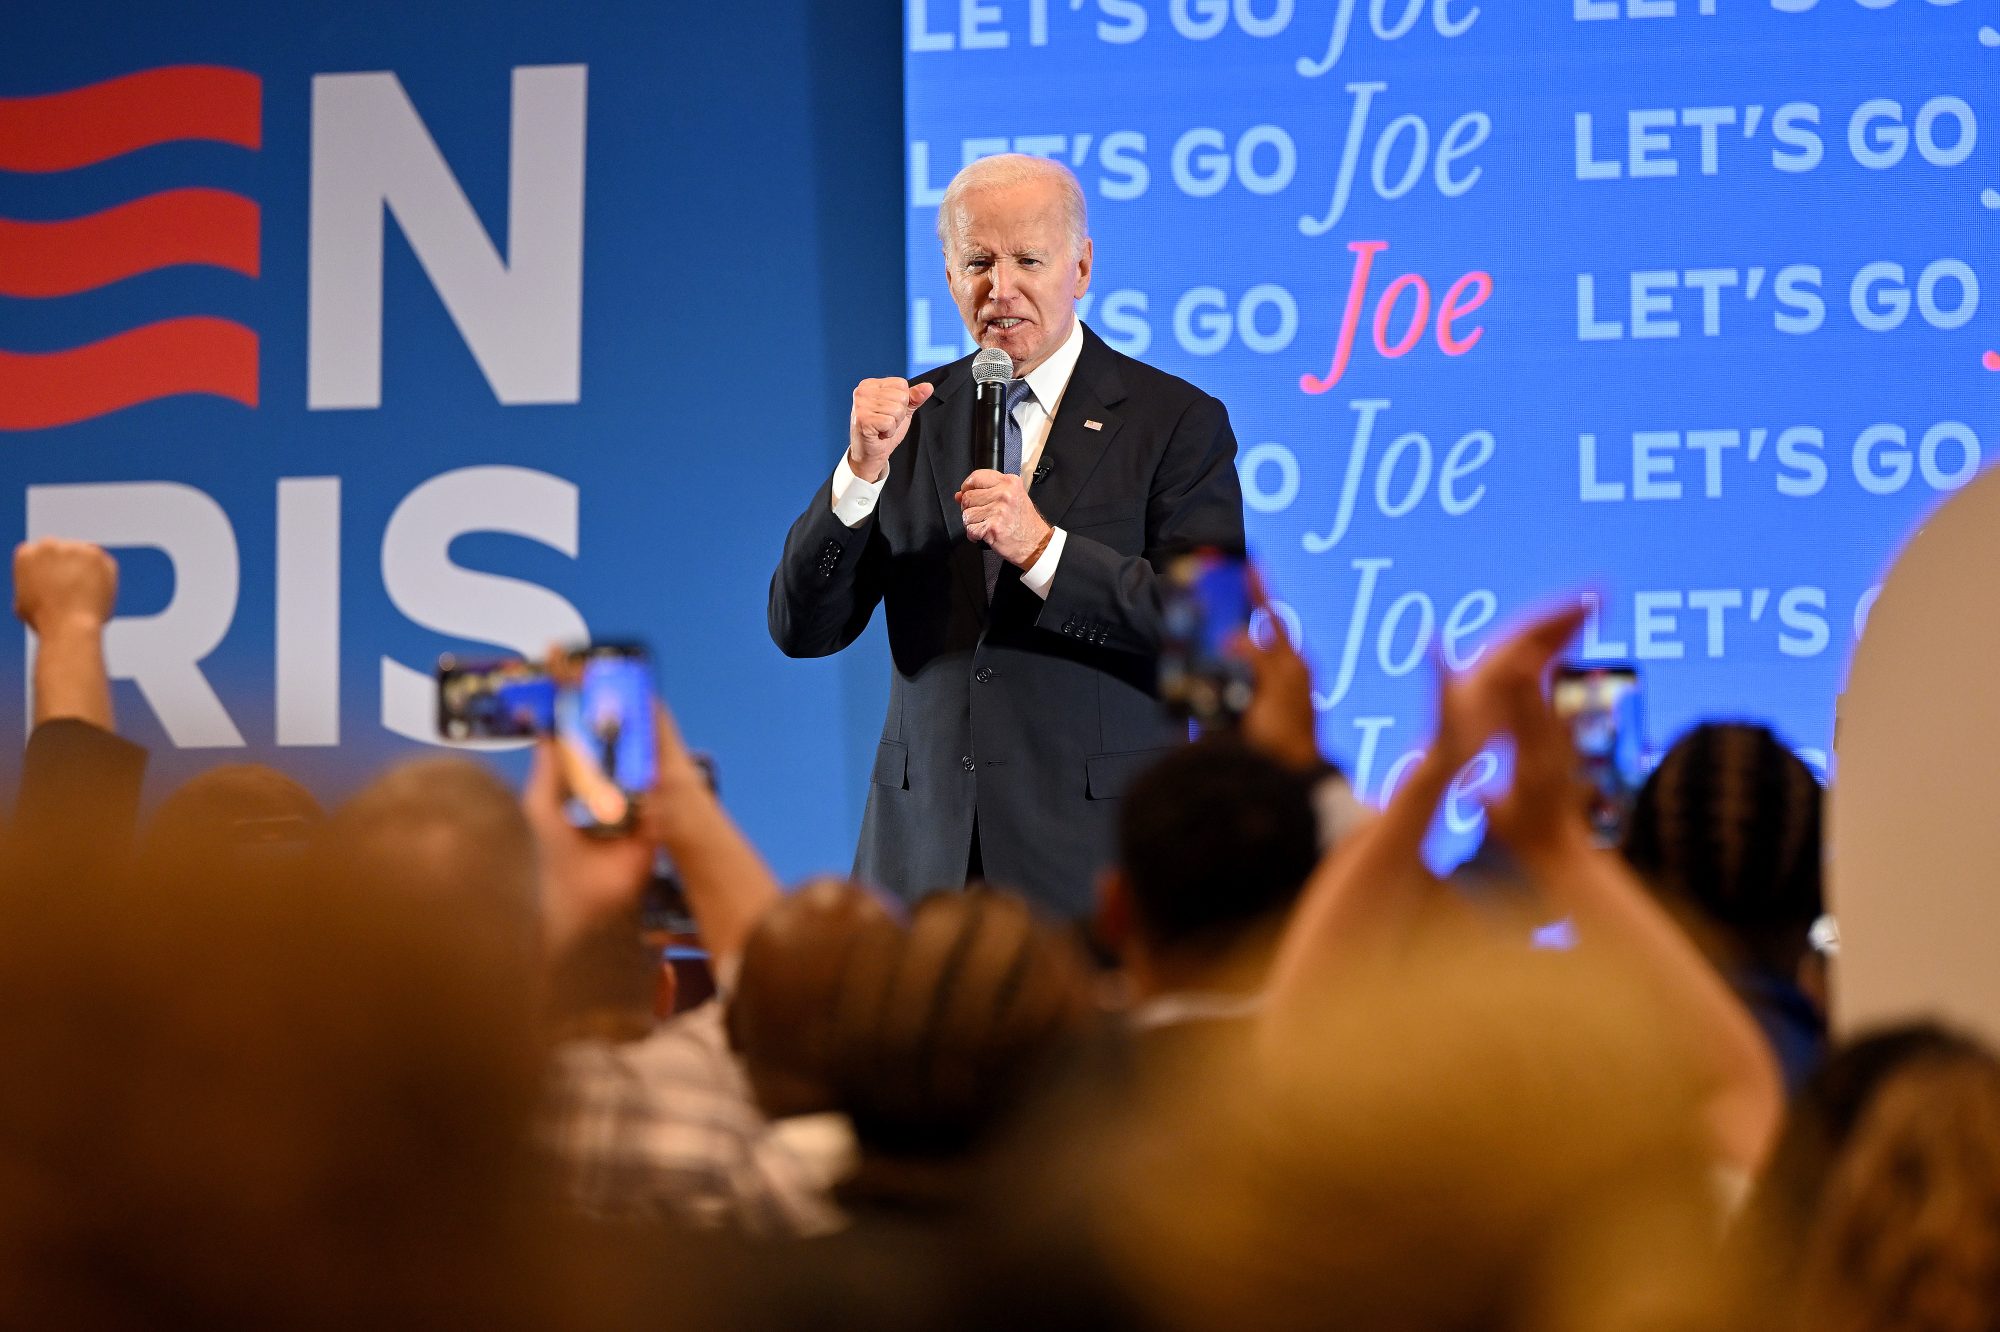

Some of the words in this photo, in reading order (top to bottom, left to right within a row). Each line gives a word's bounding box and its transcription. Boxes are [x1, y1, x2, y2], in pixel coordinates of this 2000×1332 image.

[909, 0, 1149, 51] LETS
[1171, 125, 1297, 197] GO
[1299, 82, 1491, 236] Joe
[1575, 102, 1825, 180] LET'S
[1847, 96, 1977, 169] GO
[913, 289, 1151, 366] L'S
[1173, 284, 1299, 354] GO
[1300, 241, 1493, 394] Joe
[1577, 264, 1826, 341] LET'S
[1849, 258, 1979, 332] GO
[1302, 399, 1495, 553] Joe
[1579, 426, 1828, 502] LET'S
[1851, 421, 1981, 494] GO
[25, 465, 591, 752] RIS
[1311, 558, 1497, 711] Joe
[1582, 586, 1830, 659] LET'S
